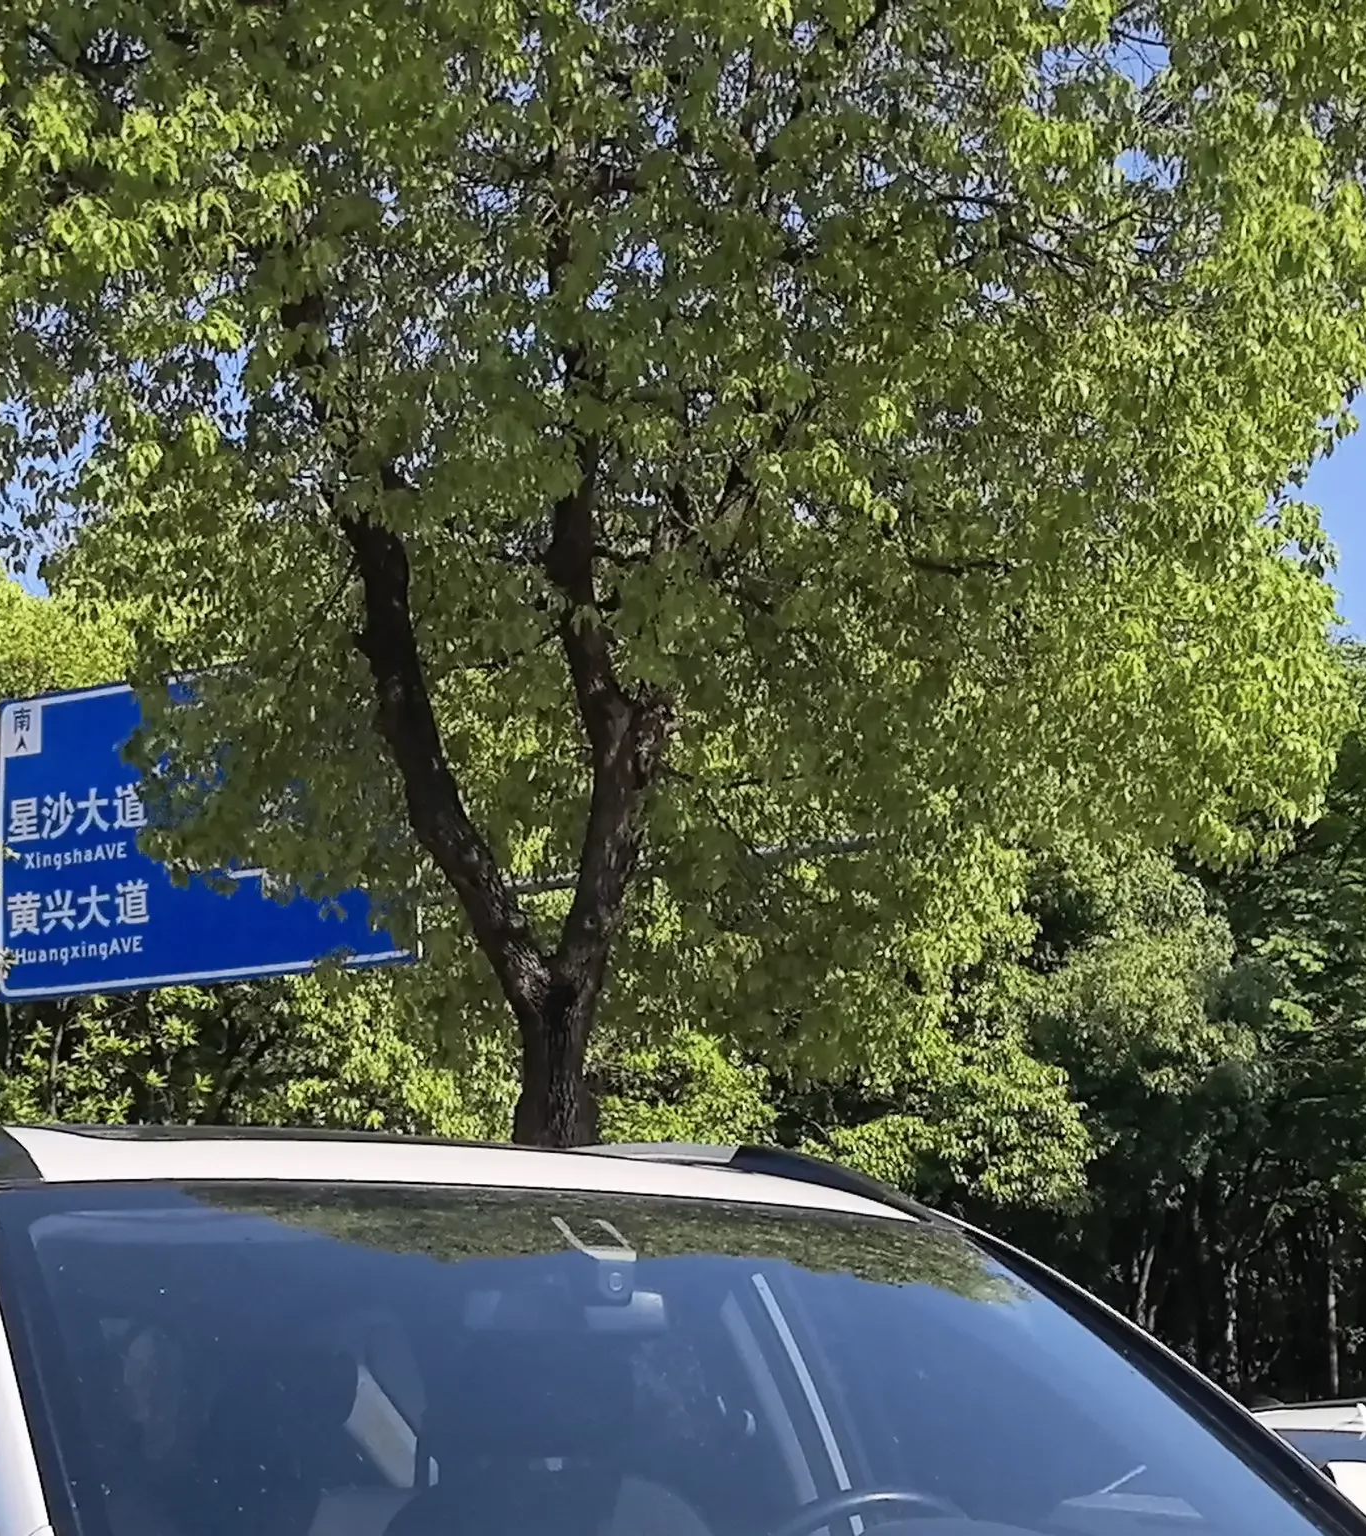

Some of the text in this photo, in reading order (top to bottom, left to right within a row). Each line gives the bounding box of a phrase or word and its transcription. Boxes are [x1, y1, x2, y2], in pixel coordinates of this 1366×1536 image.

[12, 707, 32, 734] 南
[8, 781, 148, 843] 星沙大道
[7, 878, 150, 938] 黄兴大道
